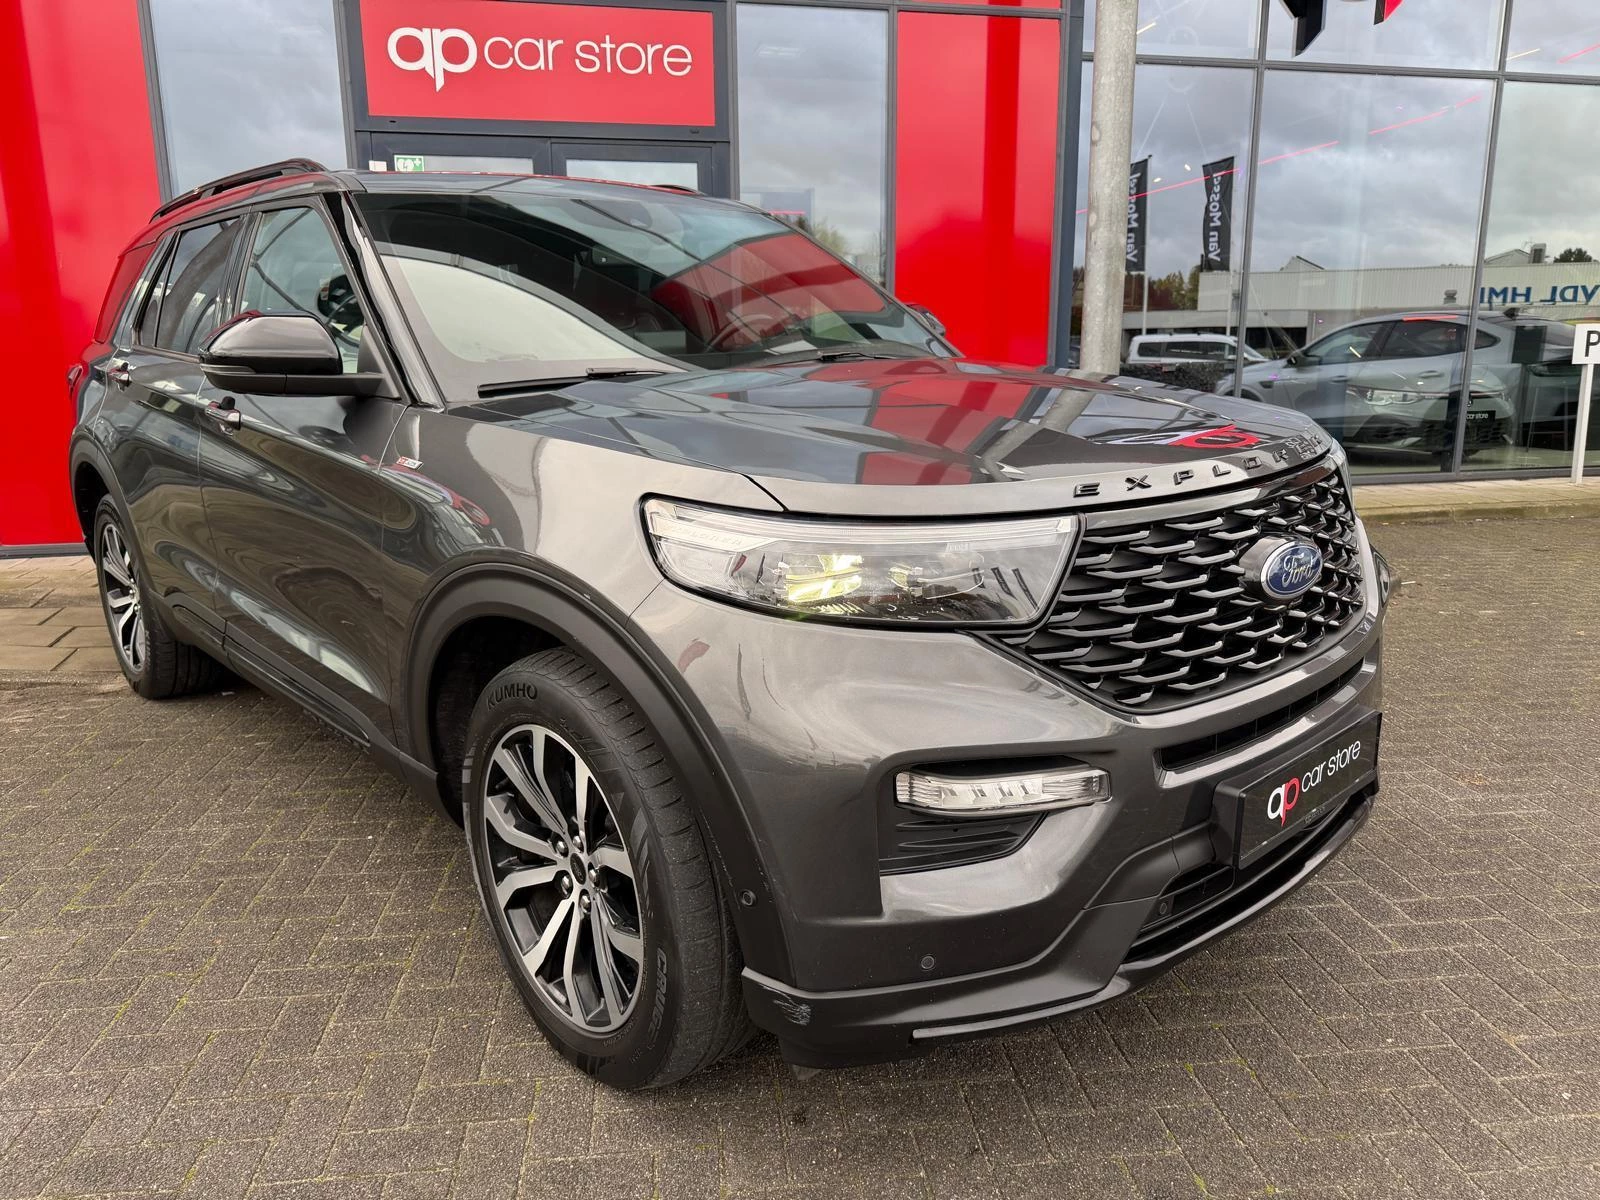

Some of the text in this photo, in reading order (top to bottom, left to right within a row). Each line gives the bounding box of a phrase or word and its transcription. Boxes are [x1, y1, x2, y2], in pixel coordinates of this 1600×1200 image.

[387, 27, 693, 92] ap car store
[1073, 434, 1322, 498] EXPLORER
[1281, 553, 1317, 588] Ford
[487, 682, 538, 710] KUMHO
[1266, 777, 1300, 828] ap
[1301, 761, 1328, 793] car
[1327, 740, 1361, 777] store
